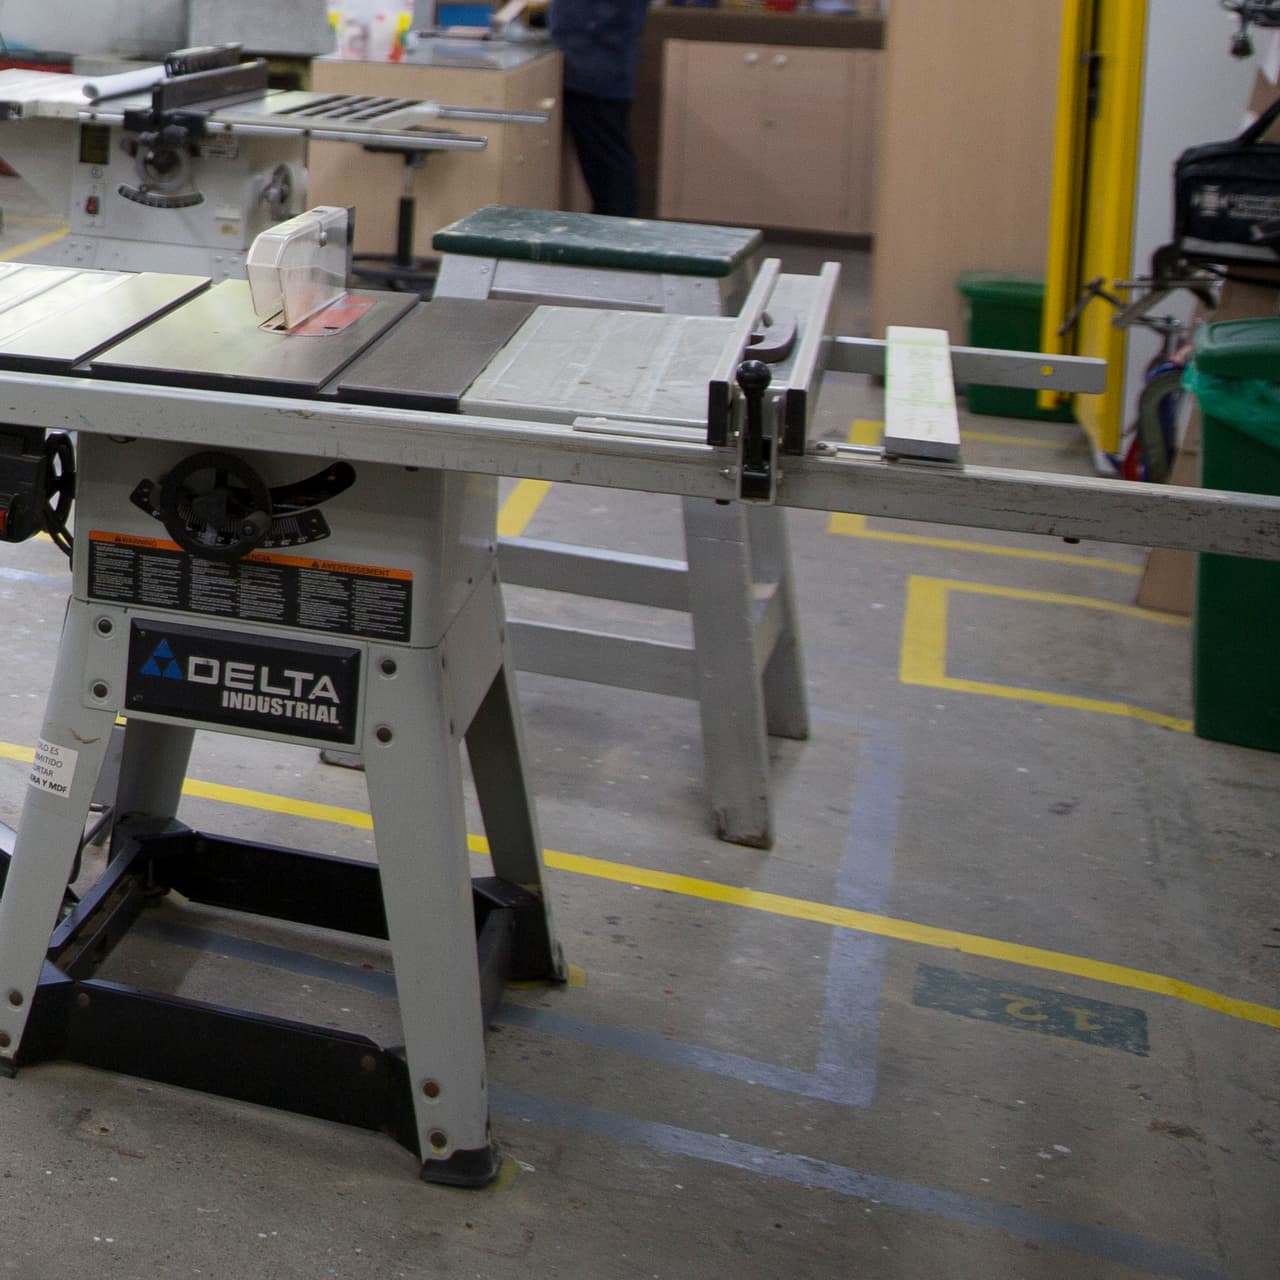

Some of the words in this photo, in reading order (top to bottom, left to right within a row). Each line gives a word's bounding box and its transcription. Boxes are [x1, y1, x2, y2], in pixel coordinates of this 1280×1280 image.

[321, 560, 390, 577] AVERTISSEMENT
[187, 655, 340, 704] DELTA
[221, 690, 340, 724] INDUSTRIAL
[50, 746, 59, 756] ES
[42, 779, 48, 788] Y
[48, 781, 68, 793] MDF
